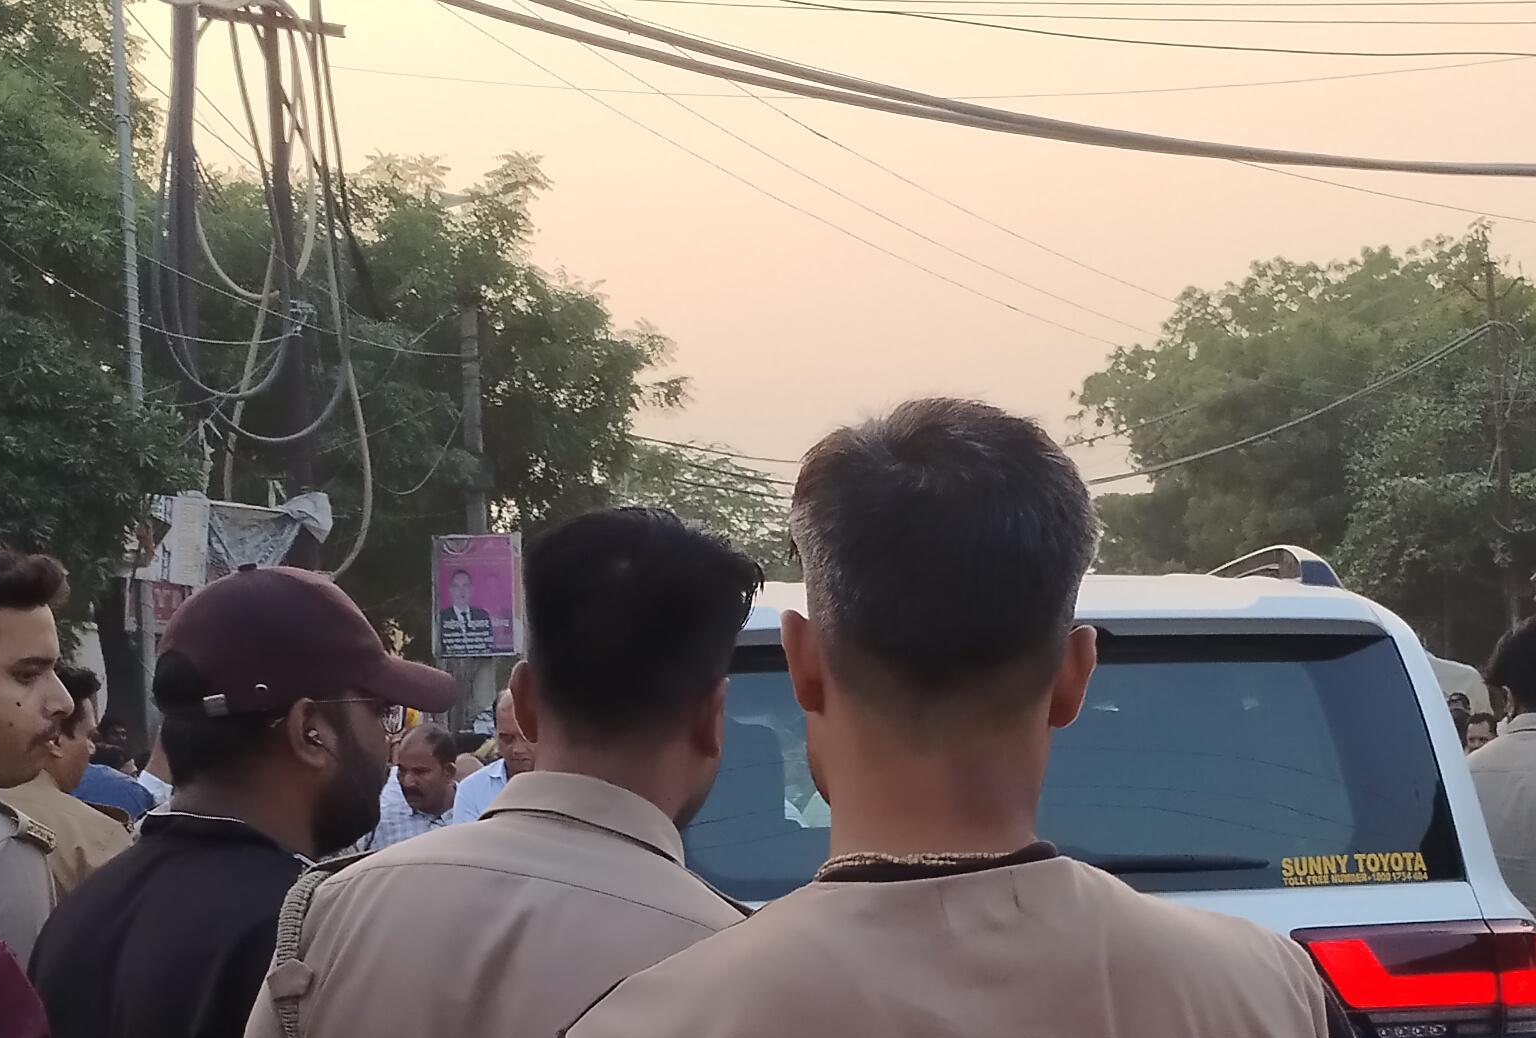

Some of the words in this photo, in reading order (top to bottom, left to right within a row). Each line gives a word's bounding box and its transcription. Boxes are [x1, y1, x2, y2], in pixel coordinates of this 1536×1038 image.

[1282, 854, 1349, 877] SUNNY
[1353, 851, 1427, 873] TOYOTA
[1282, 876, 1306, 887] TOLL
[1307, 874, 1330, 885] FREE
